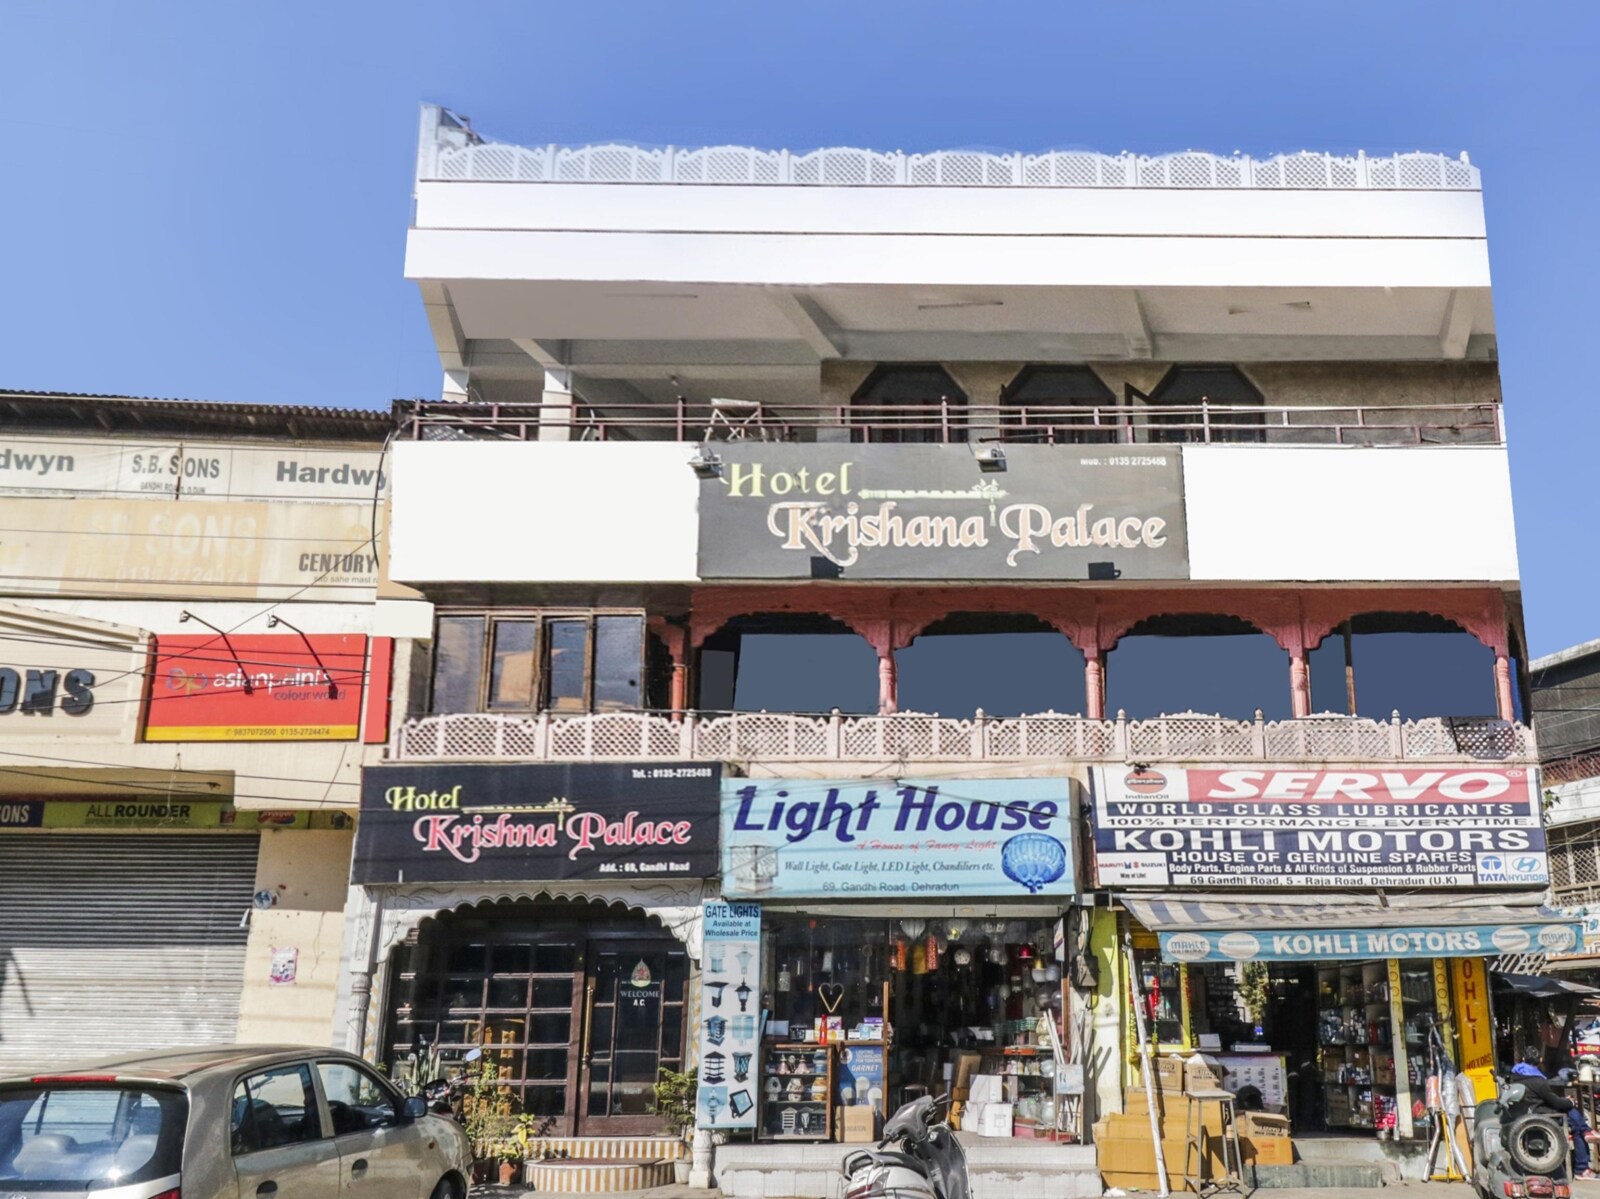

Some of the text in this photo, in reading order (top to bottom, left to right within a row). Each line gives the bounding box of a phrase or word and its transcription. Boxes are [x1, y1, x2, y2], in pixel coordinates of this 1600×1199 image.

[132, 454, 220, 479] S.B. SONS
[1108, 456, 1130, 466] 0135
[718, 461, 853, 497] Hotel
[767, 501, 1167, 567] Krishana Palace
[299, 553, 377, 573] CENTURY
[1208, 771, 1510, 800] SERVO
[385, 785, 463, 812] Hotel
[0, 804, 30, 823] ONS
[86, 804, 191, 818] ALL ROUNDER
[733, 785, 1058, 842] Light House
[1338, 804, 1514, 815] LUBRICANTS
[1107, 818, 1164, 826] 100%
[412, 811, 692, 864] Krishna Palace
[1114, 829, 1530, 851] KOHLI MOTORS
[925, 839, 960, 852] Fancy
[964, 839, 998, 852] Light
[1172, 852, 1472, 864] HOUSE OF GENUINE SPARES
[639, 862, 667, 872] Gandhi
[669, 861, 690, 871] Road
[785, 861, 804, 871] Wall
[832, 861, 852, 871] Gate
[881, 862, 903, 872] LED
[1169, 863, 1192, 874] Body
[1194, 864, 1222, 873] Parts,
[1224, 864, 1256, 874] Engine
[1258, 864, 1282, 873] Parts
[1295, 864, 1307, 873] All
[1309, 864, 1336, 873] Kinds
[1338, 864, 1347, 873] of
[1349, 864, 1403, 875] Suspension
[1416, 864, 1450, 873] Rubber
[1452, 863, 1477, 873] Parts
[1190, 876, 1204, 885] 69
[1208, 875, 1247, 885] Gandhi
[1305, 877, 1331, 887] Raja
[1371, 876, 1425, 886] Dehradun
[1479, 873, 1507, 882] TATA
[1508, 873, 1547, 882] HYUNDAI
[841, 881, 877, 892] Gandhi
[911, 882, 960, 891] Dehradun
[706, 905, 759, 918] GATE LIGHTS
[1273, 931, 1481, 955] KOHLI MOTORS
[620, 990, 660, 998] WELCOME
[1466, 1053, 1492, 1069] MOTORS
